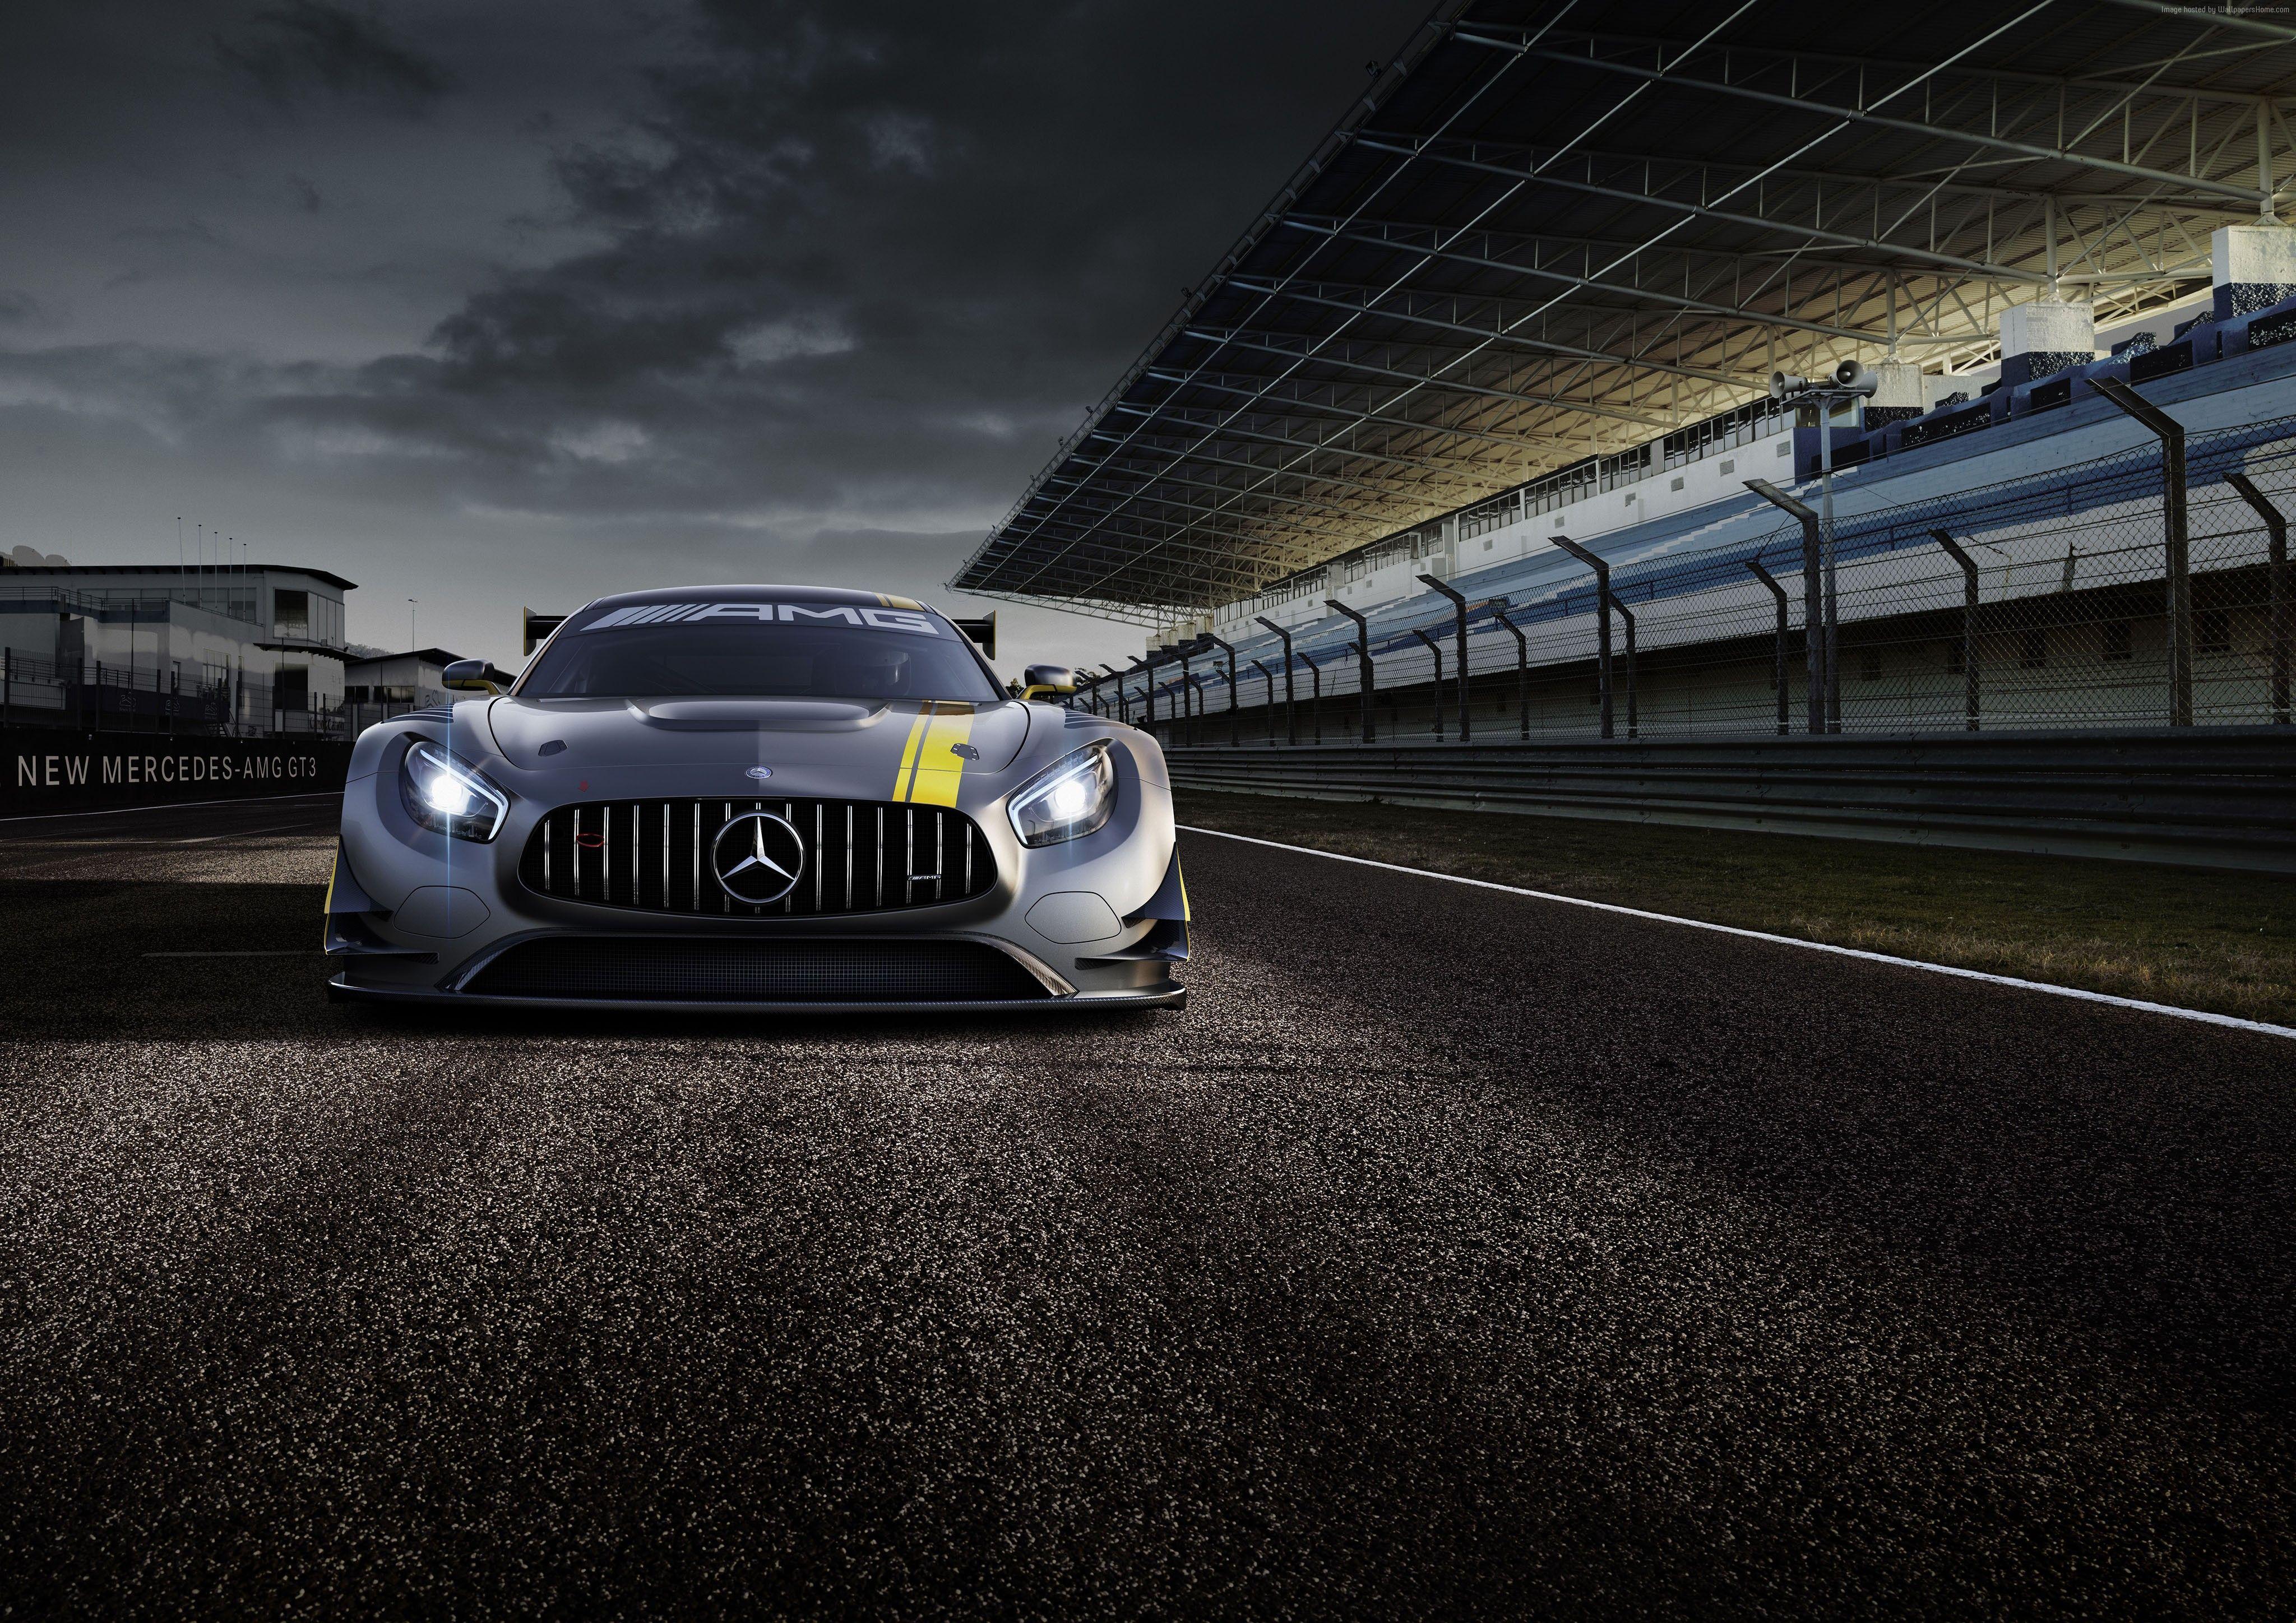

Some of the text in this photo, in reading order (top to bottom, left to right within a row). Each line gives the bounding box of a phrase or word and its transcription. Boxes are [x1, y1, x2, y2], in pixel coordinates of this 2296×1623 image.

[682, 604, 939, 634] AMG
[18, 755, 317, 786] NEW MERCEDES-AMG GT3
